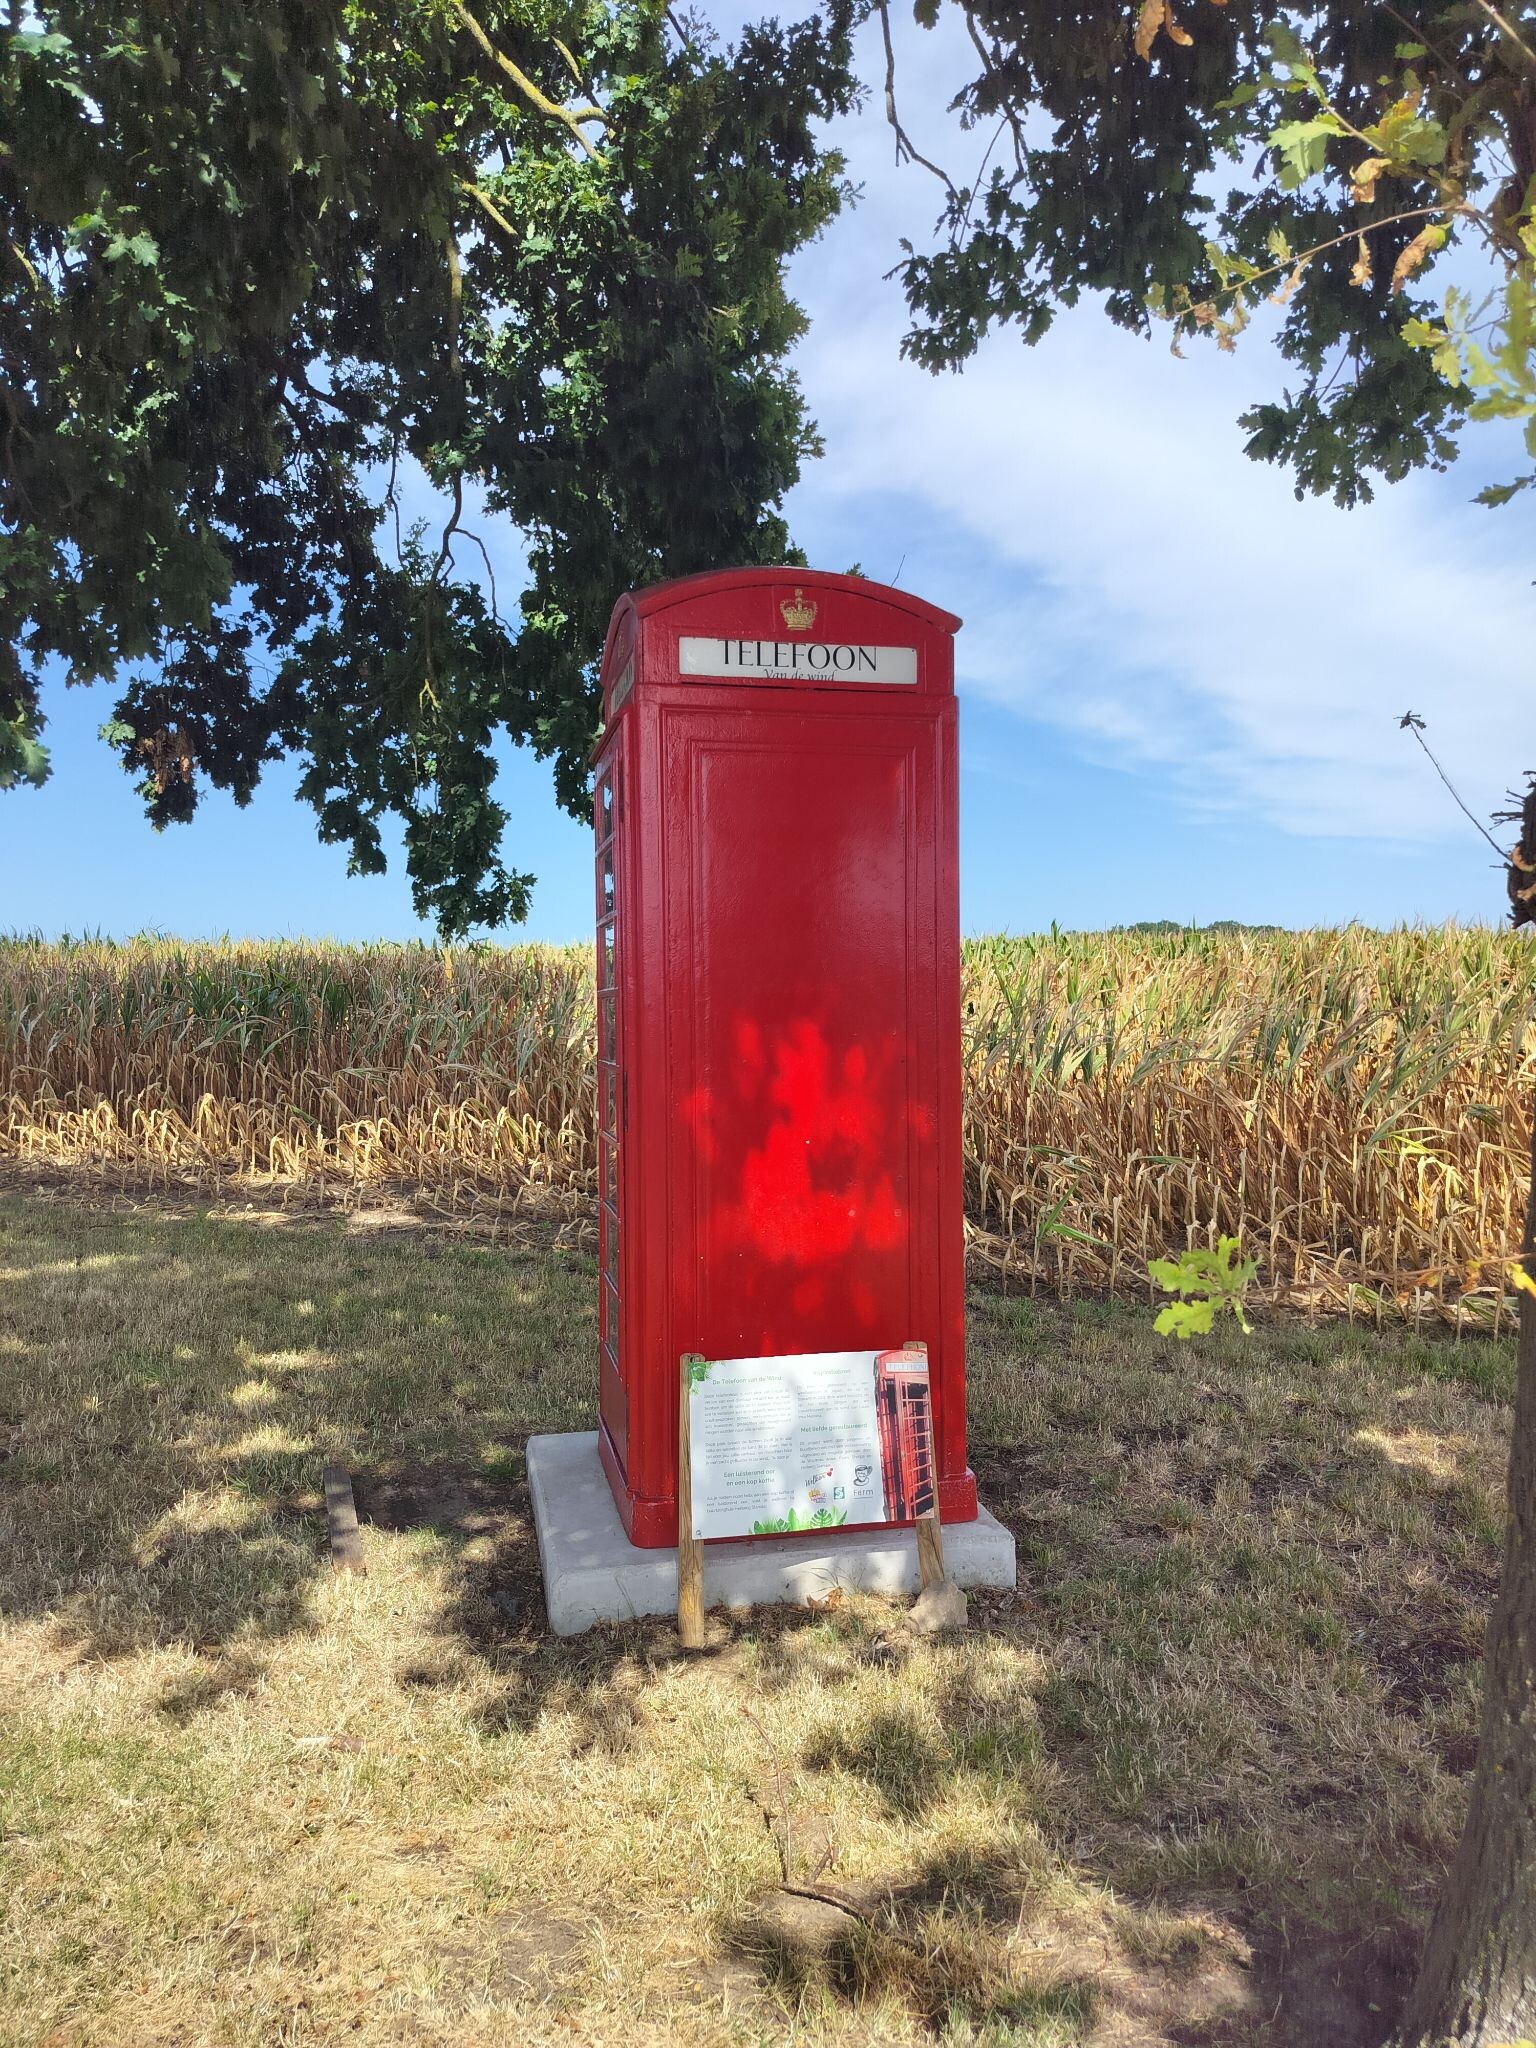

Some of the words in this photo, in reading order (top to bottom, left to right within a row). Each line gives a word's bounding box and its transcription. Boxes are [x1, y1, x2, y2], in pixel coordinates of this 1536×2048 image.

[717, 639, 877, 671] TELEFOON
[764, 668, 788, 680] Van
[791, 667, 803, 680] de
[807, 669, 837, 681] wind
